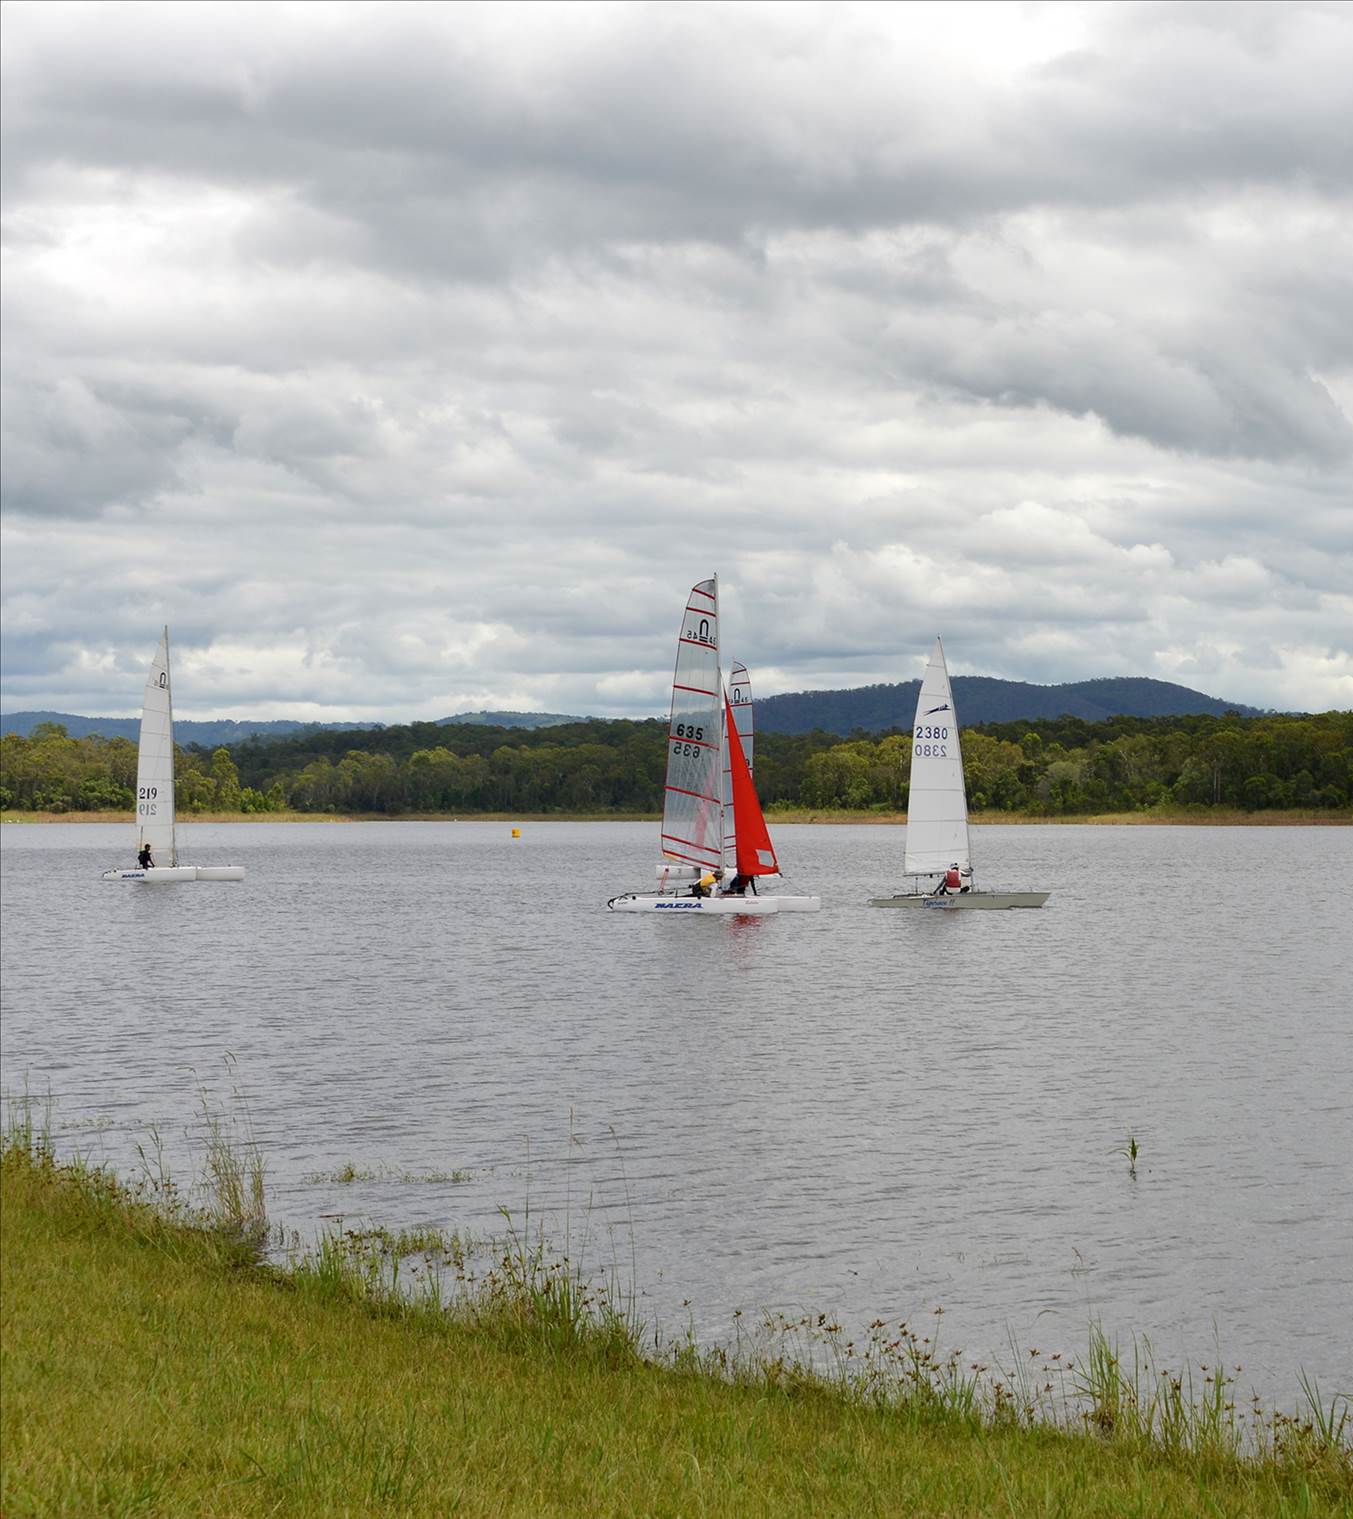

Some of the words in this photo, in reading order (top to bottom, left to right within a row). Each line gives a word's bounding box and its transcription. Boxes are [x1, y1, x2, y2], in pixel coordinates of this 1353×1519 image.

[677, 724, 704, 741] 635
[916, 726, 948, 740] 2380
[139, 787, 158, 800] 219
